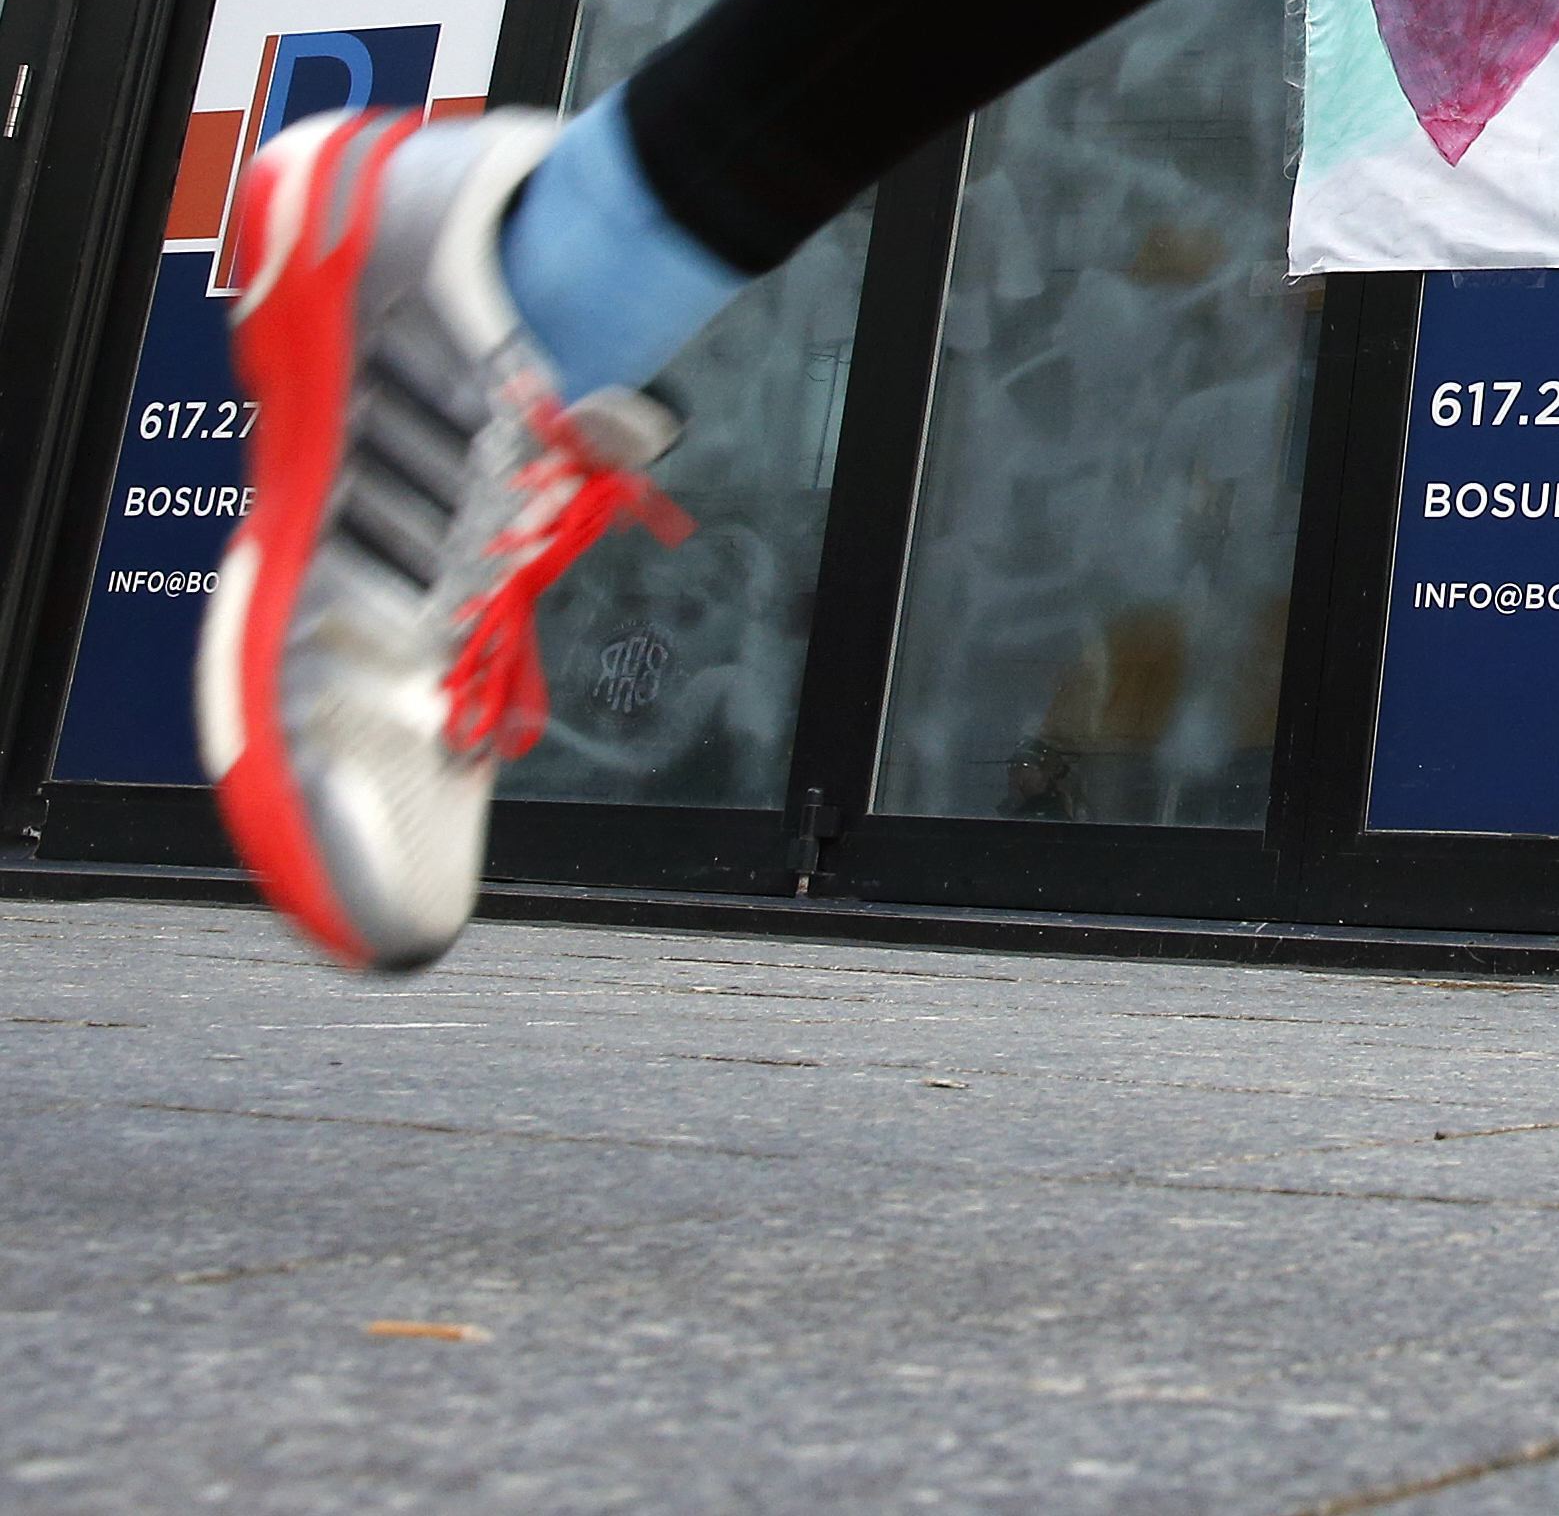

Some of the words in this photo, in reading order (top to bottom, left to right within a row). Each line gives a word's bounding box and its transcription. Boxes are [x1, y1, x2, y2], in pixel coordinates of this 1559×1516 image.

[138, 400, 262, 440] 617.27
[122, 485, 257, 518] BOSUR
[106, 569, 220, 598] INFO@BO
